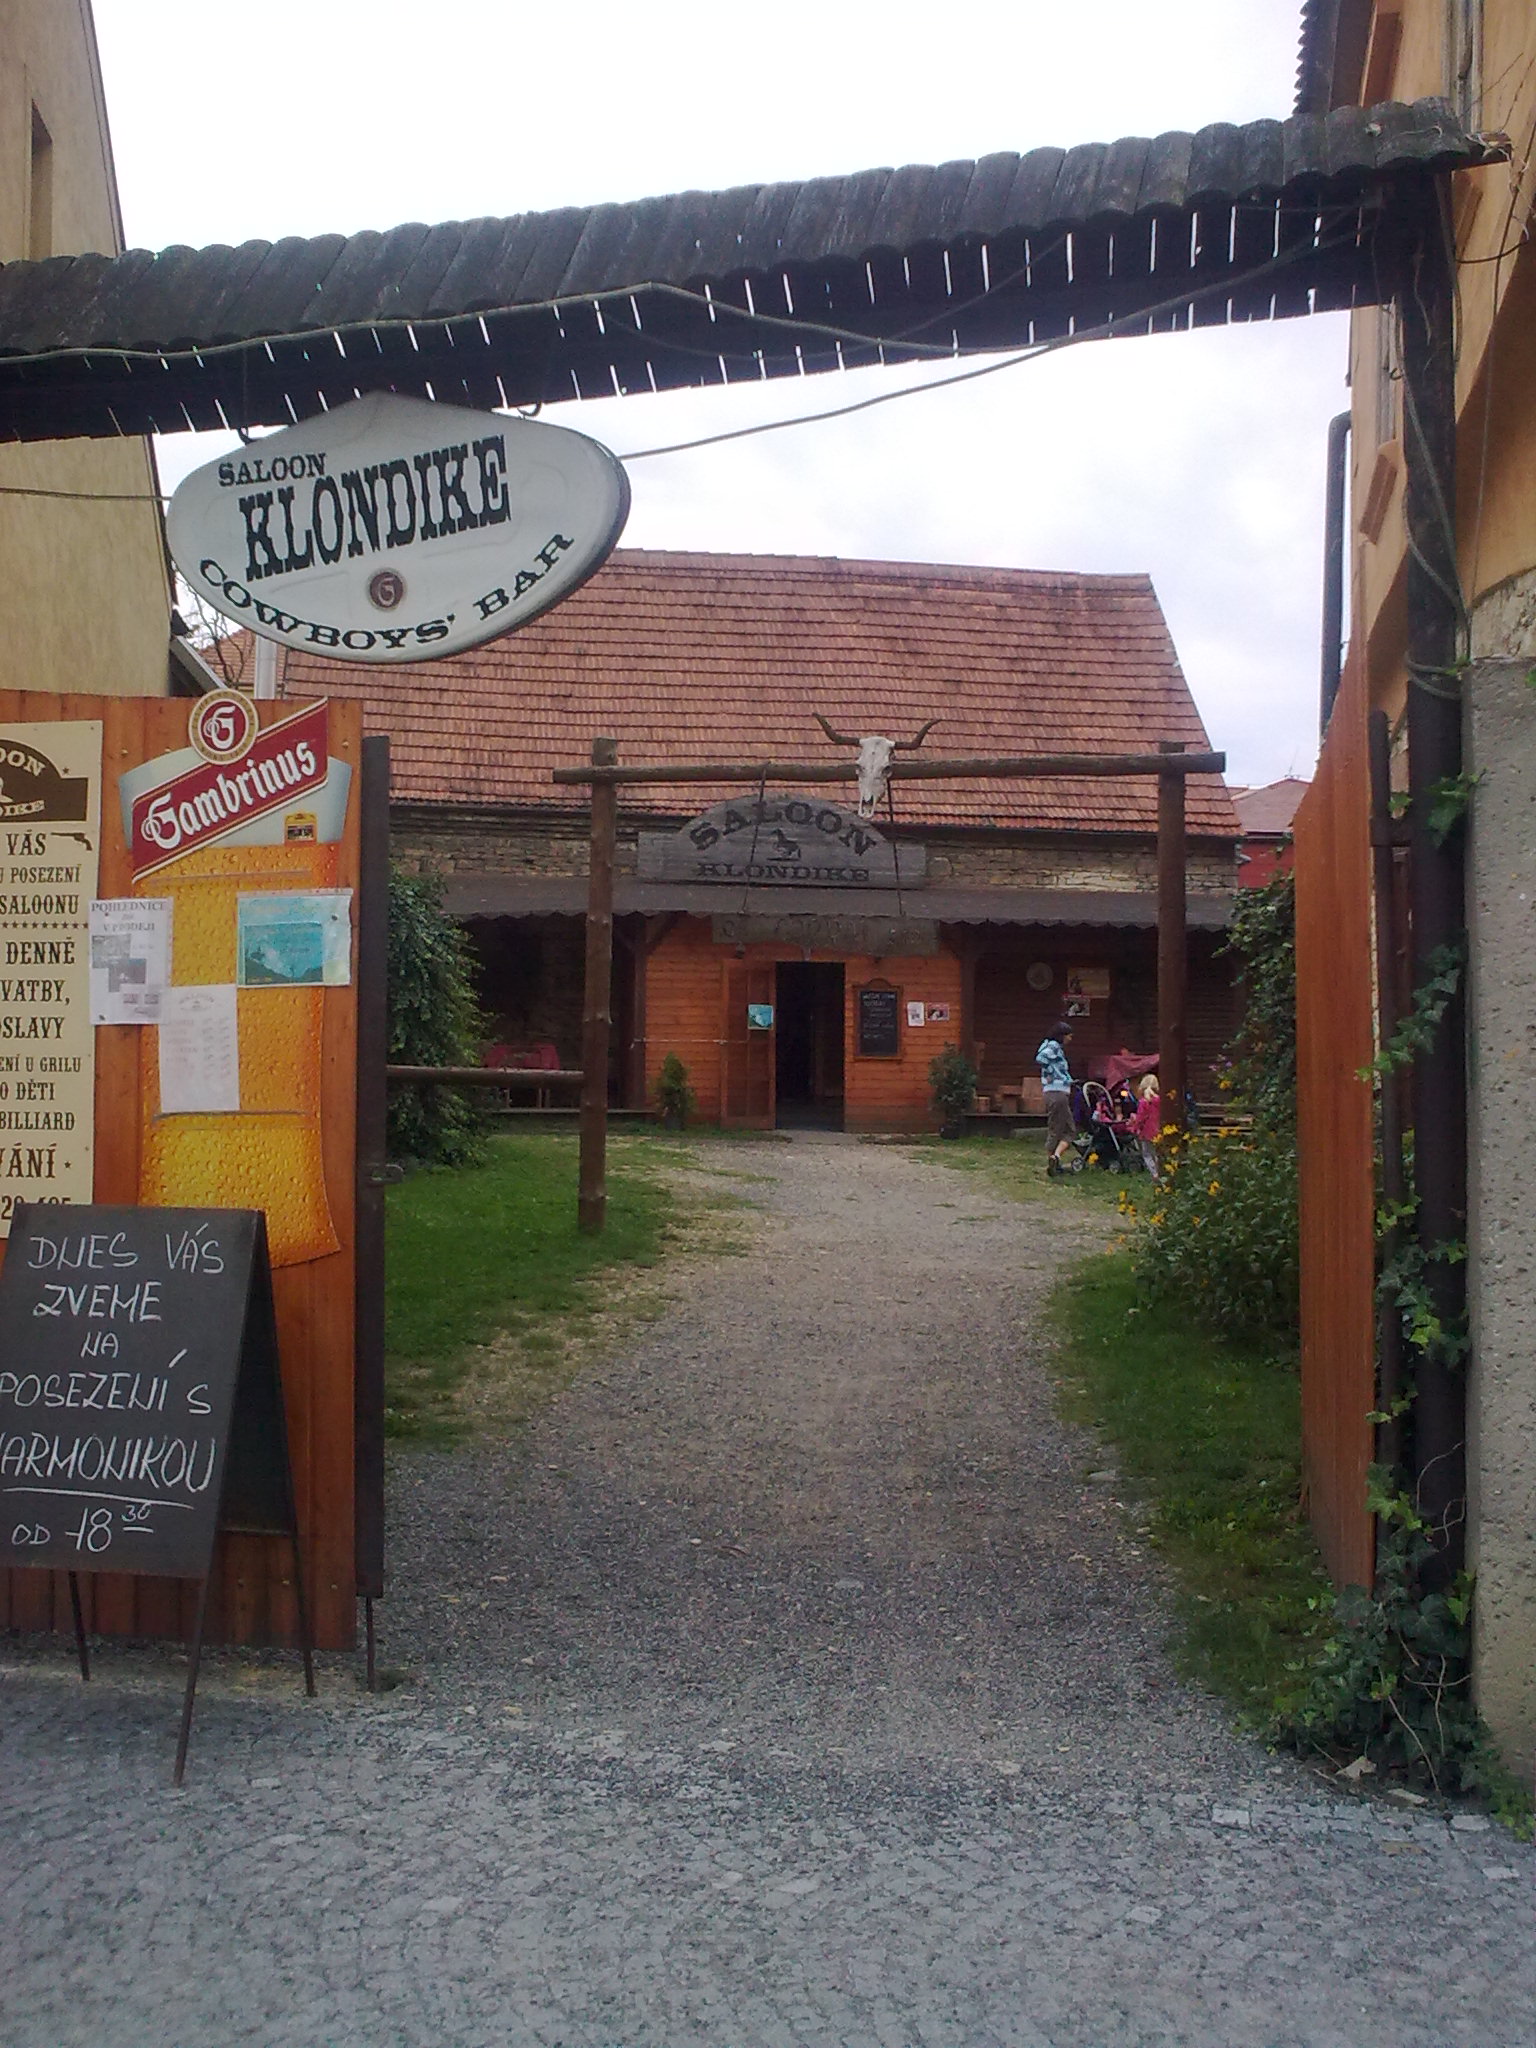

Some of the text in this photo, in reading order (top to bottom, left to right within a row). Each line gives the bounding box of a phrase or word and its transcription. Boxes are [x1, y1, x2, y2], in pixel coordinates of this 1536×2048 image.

[218, 453, 326, 488] SALOON
[239, 435, 512, 582] KLONDIKE
[201, 534, 575, 649] COWBOYS' BAR
[141, 741, 316, 849] Gambrinus
[689, 801, 877, 855] SALOON
[6, 829, 46, 856] VÁS
[10, 864, 82, 883] POSEZENÍ
[697, 864, 869, 882] KLONDIKE
[0, 894, 79, 914] SALOONU
[6, 937, 75, 964] DENNĚ
[0, 979, 70, 1005] VATBY,
[0, 1016, 64, 1039] SLAVY
[26, 1057, 34, 1072] U
[40, 1057, 81, 1072] GRILU
[16, 1079, 55, 1100] DĚTI
[0, 1111, 75, 1130] BILLIARD
[28, 1222, 225, 1274] DNES VÁS
[33, 1281, 162, 1322] ZVEME
[80, 1331, 120, 1359] NA
[0, 1348, 213, 1415] POSEZENÍ S
[11, 1523, 51, 1546] OD
